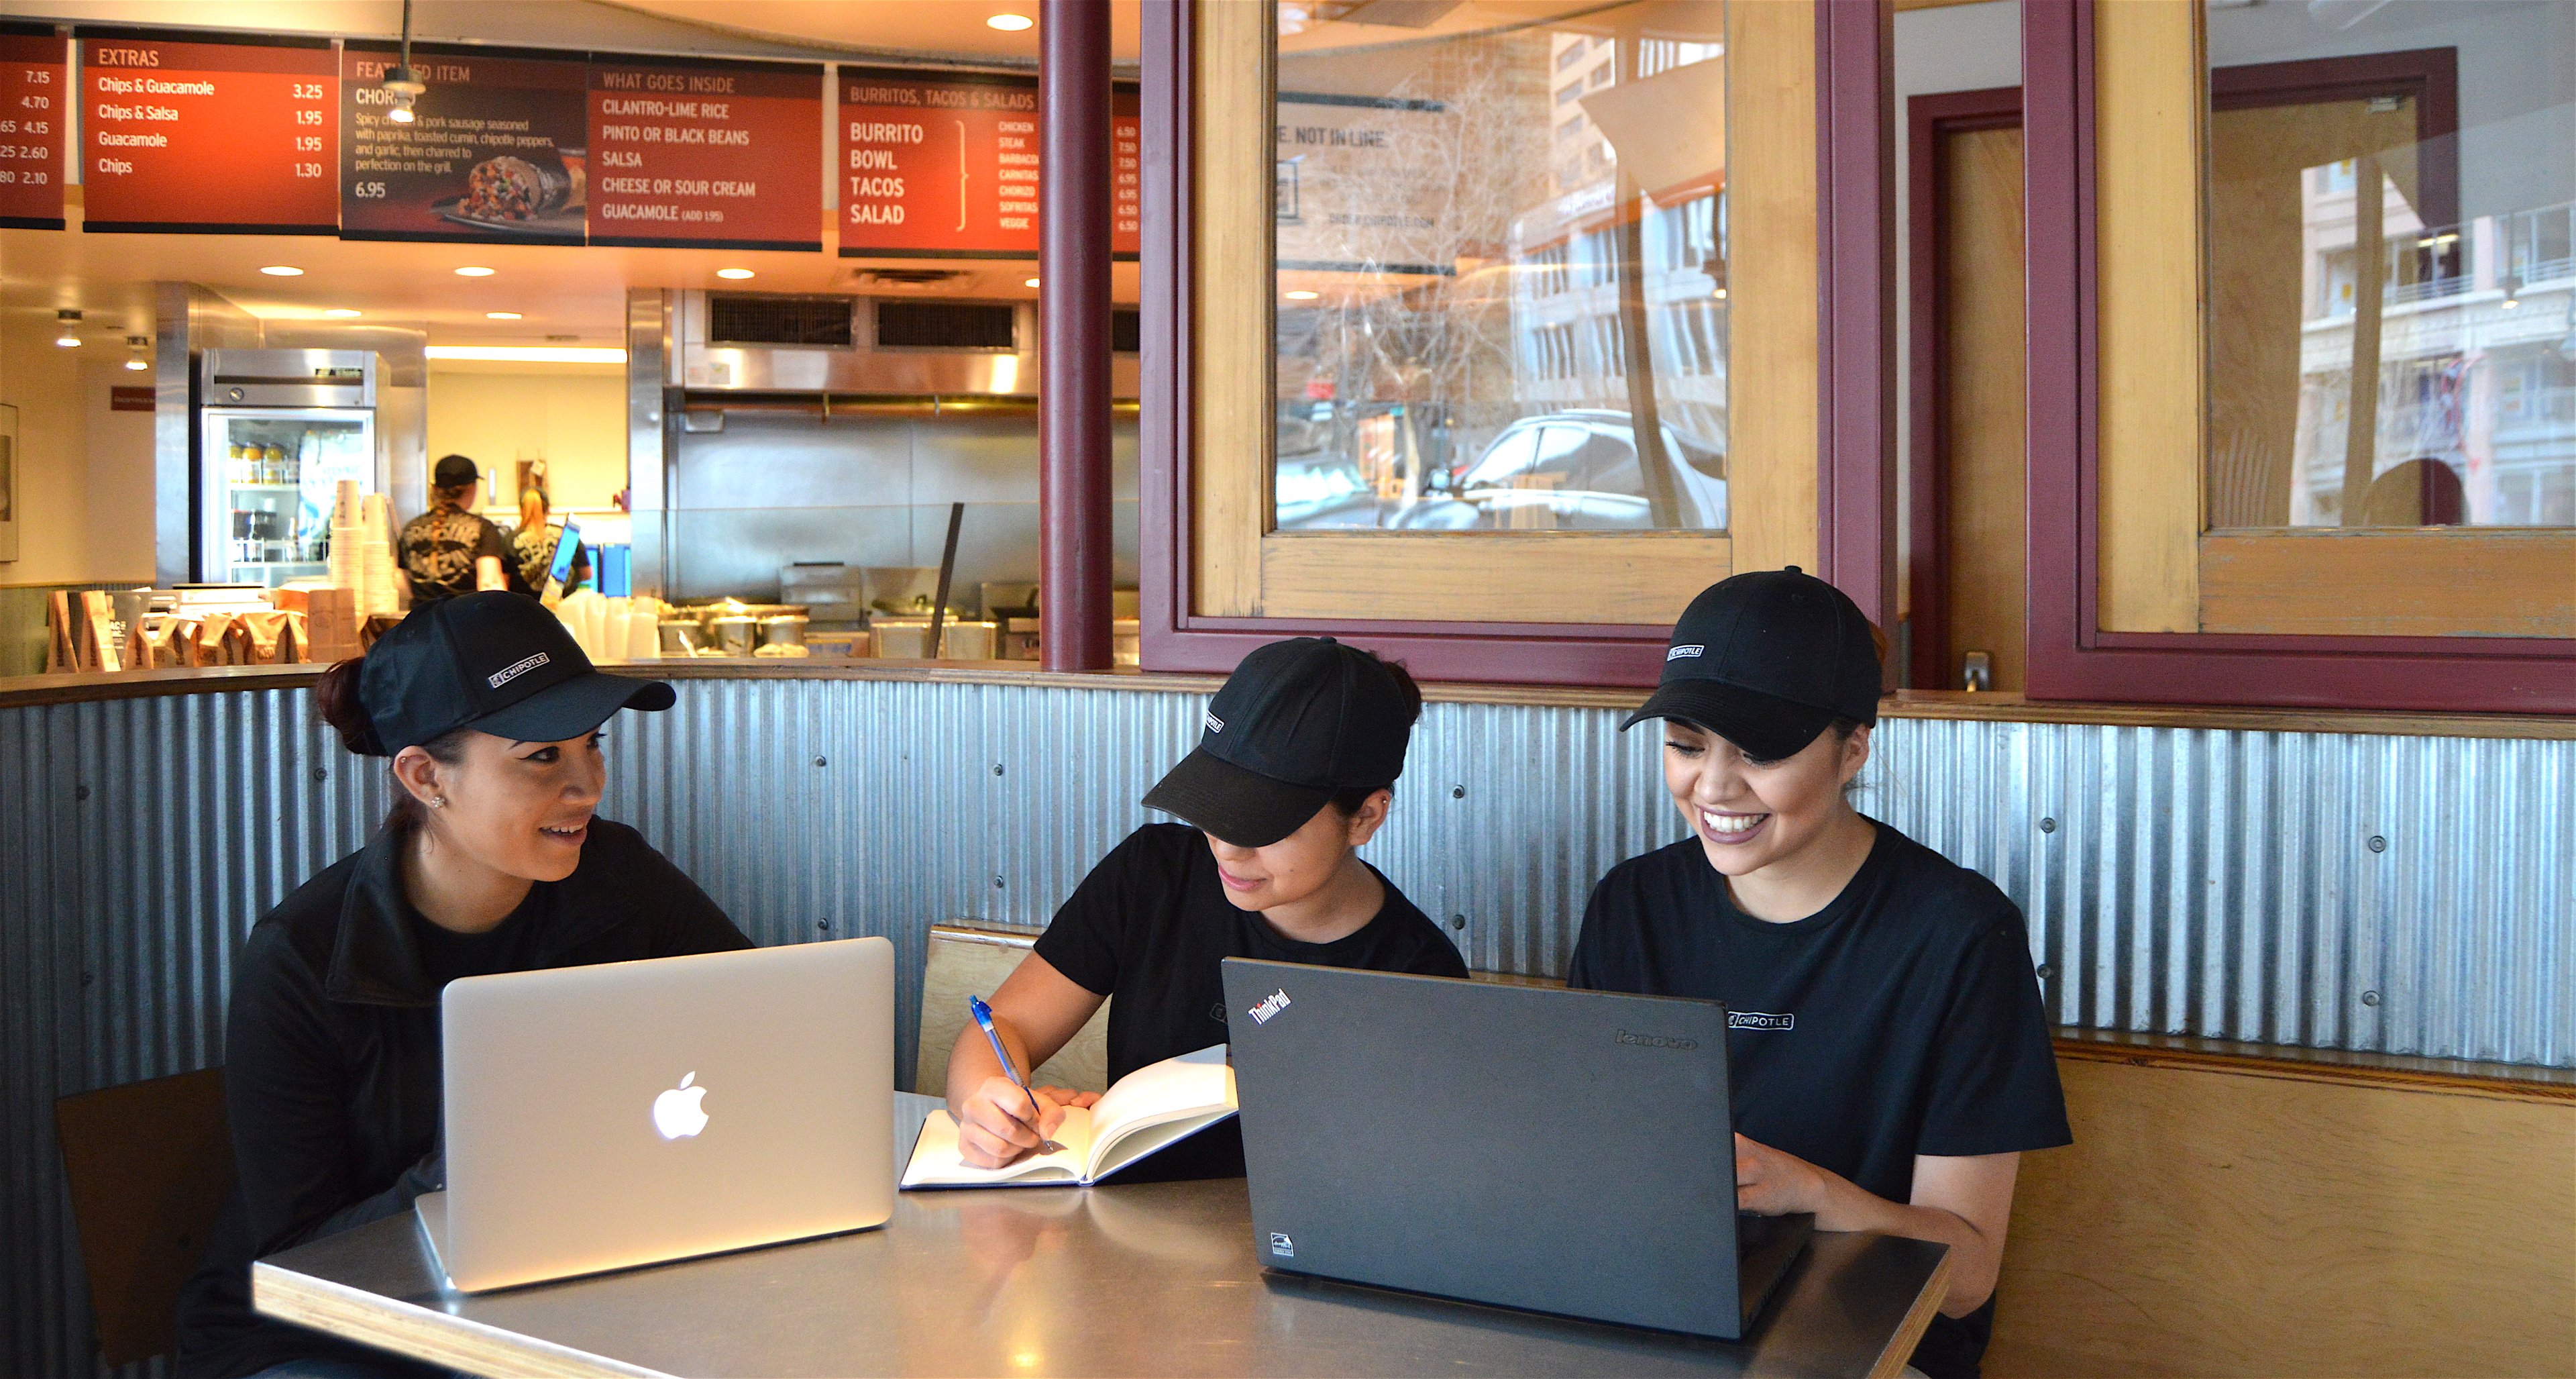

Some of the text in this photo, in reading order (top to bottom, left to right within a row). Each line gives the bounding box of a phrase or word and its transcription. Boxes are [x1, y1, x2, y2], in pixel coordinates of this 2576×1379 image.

[98, 48, 159, 67] EXTRAS
[26, 70, 50, 84] 7.15
[357, 61, 470, 81] FEAD ITEM
[99, 76, 323, 99] Chips & Guacamole 3.25
[604, 72, 735, 93] WHAT GOES INSIDE
[21, 96, 49, 109] 4.70
[356, 88, 416, 105] CHOR
[851, 87, 1034, 109] BURRITOS, TACOS & SALADS
[99, 104, 323, 125] Chips & Salsa 1.95
[603, 99, 729, 119] CILANTRO-LIME RICE
[24, 121, 49, 134] 4.15
[356, 112, 380, 127] Spicy
[425, 117, 447, 128] pork
[448, 119, 485, 132] sausage
[487, 119, 529, 132] seasoned
[999, 121, 1034, 133] CHICKEN
[99, 131, 323, 152] Guacamole 1.95
[356, 127, 375, 140] with
[414, 131, 447, 143] toasted
[480, 134, 515, 147] chipotle
[603, 125, 749, 146] PINTO OR BLACK BEANS
[851, 122, 923, 144] BURRITO
[999, 137, 1025, 148] STEAK
[1295, 126, 1326, 144] NOT
[1330, 128, 1346, 145] IN
[20, 146, 48, 160] 2.60
[356, 143, 373, 155] and
[403, 145, 424, 156] then
[425, 146, 460, 158] charred
[462, 147, 472, 158] to
[602, 151, 643, 168] SALSA
[851, 150, 898, 170] BOWL
[999, 153, 1039, 165] BARBACO
[99, 158, 322, 178] Chips 1.30
[356, 159, 402, 172] perfection
[403, 160, 415, 172] on
[417, 161, 432, 172] the
[999, 169, 1039, 181] CARNITAS
[23, 171, 48, 185] 2.10
[602, 177, 756, 197] CHEESE OR SOUR CREAM
[851, 176, 904, 197] TACOS
[356, 182, 386, 199] 6.95
[999, 185, 1036, 198] CHORIZO
[602, 203, 679, 221] GUACAMOLE
[682, 210, 703, 221] (ADD
[851, 204, 905, 224] SALAD
[999, 201, 1038, 213] SOFRITAS
[1000, 217, 1030, 229] VEGGIE
[1673, 648, 1701, 656] CHIPOTLE
[502, 655, 547, 678] CHIPOTLE
[1248, 988, 1291, 1025] ThinkPad
[1738, 1016, 1789, 1026] CHIPOTLE
[1615, 1029, 1698, 1050] lenovo
